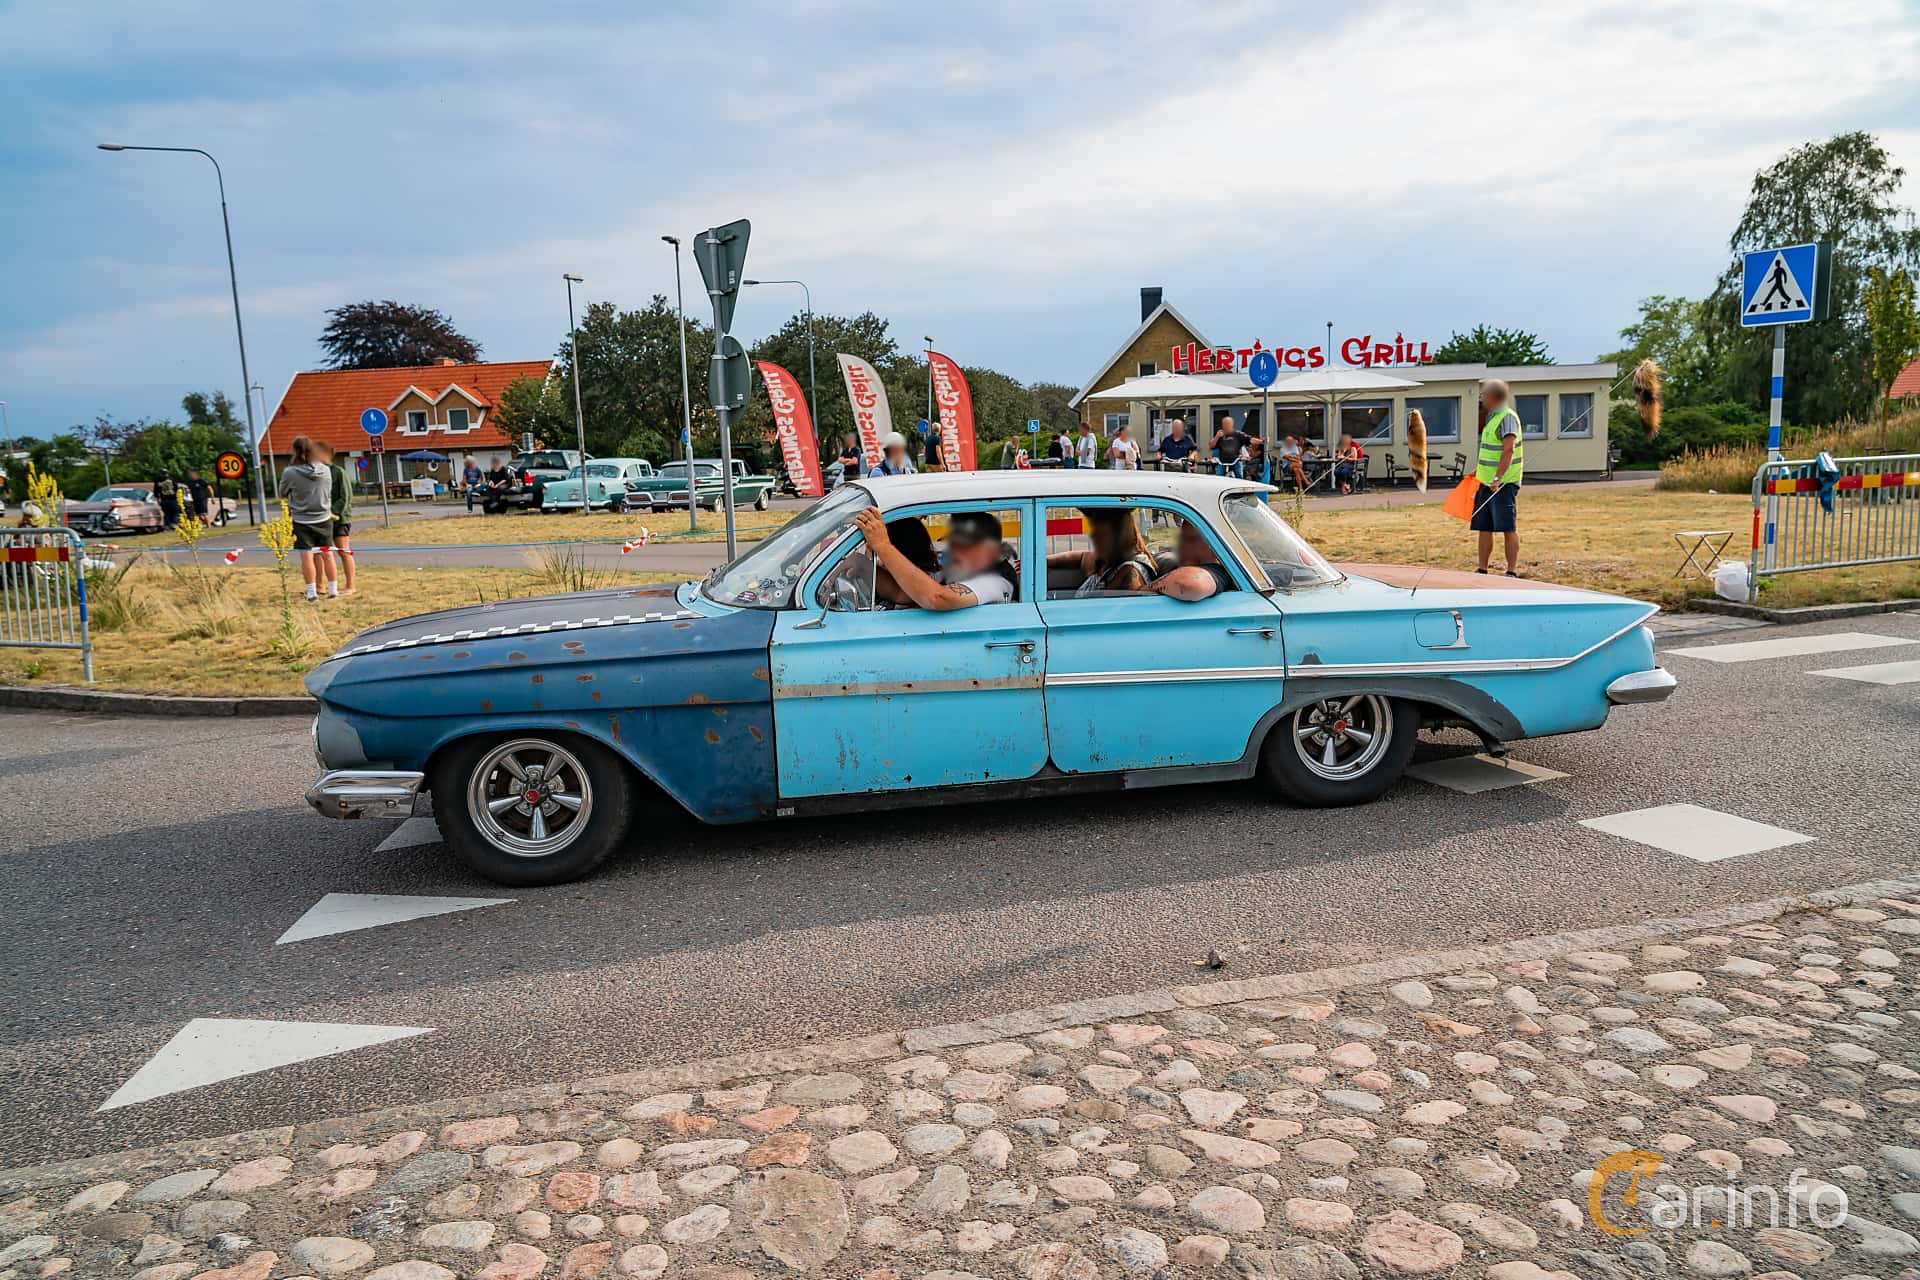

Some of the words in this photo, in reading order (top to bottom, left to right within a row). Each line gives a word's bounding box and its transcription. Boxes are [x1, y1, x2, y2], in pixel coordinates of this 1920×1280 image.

[1172, 338, 1326, 374] HERTGS
[1341, 332, 1435, 368] GRILL
[222, 459, 240, 472] 30
